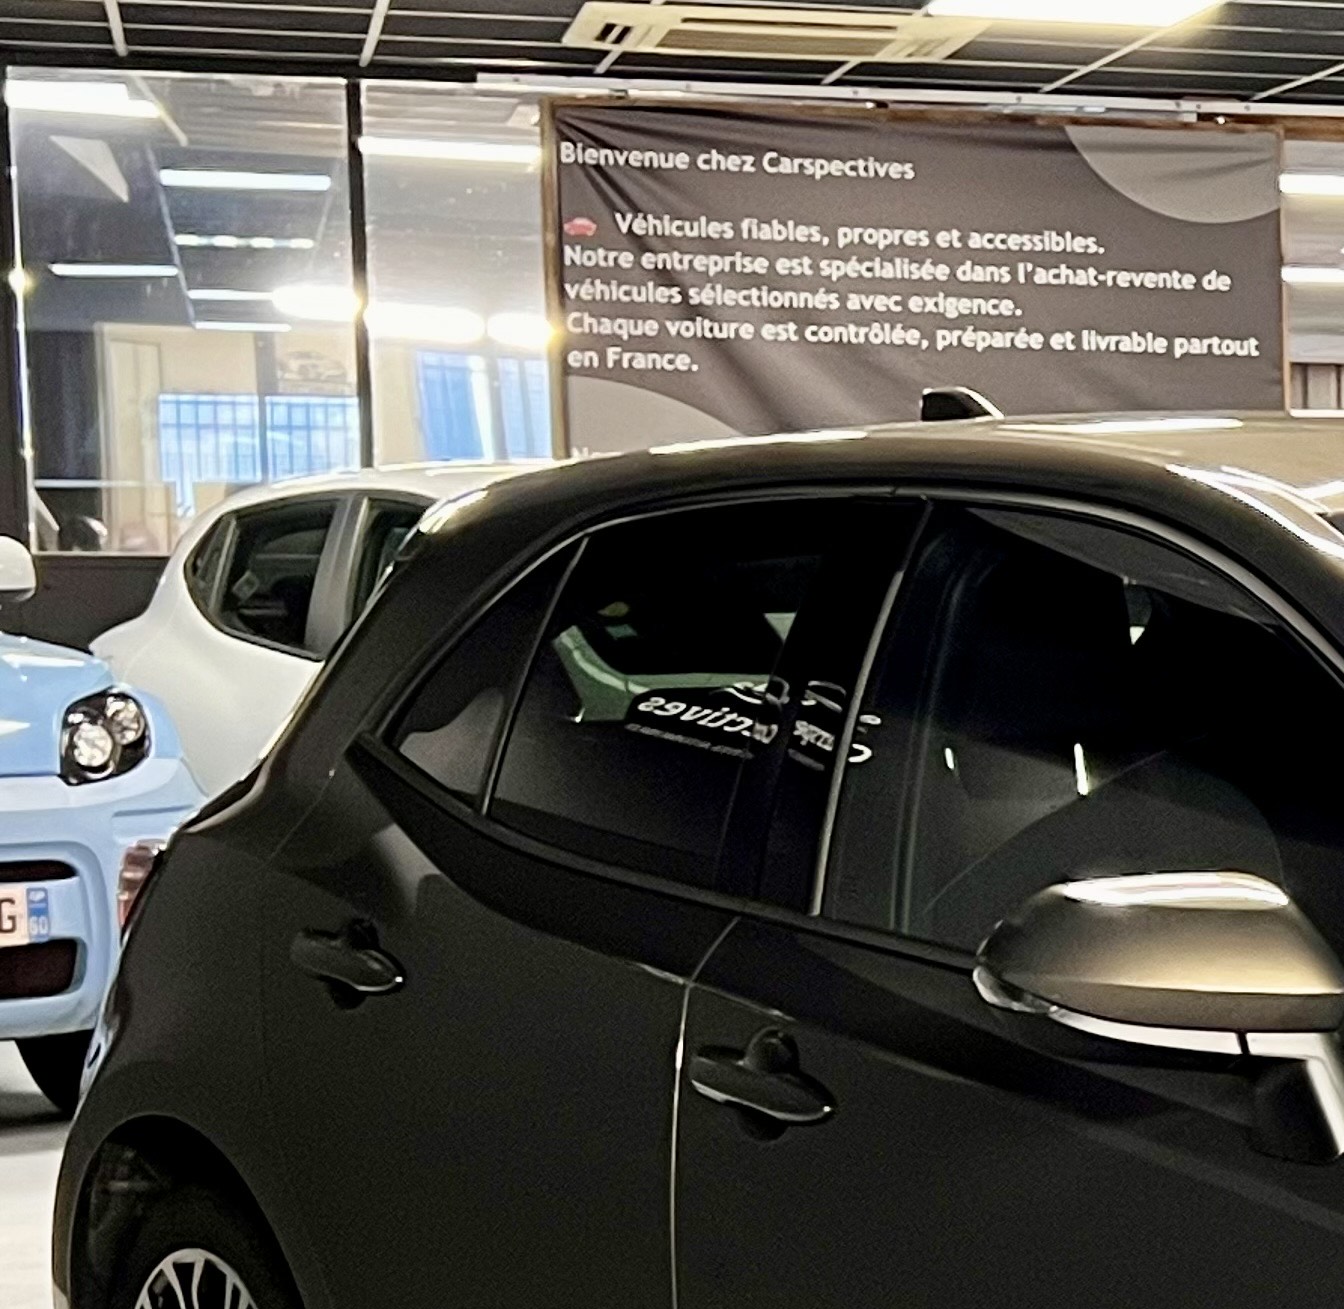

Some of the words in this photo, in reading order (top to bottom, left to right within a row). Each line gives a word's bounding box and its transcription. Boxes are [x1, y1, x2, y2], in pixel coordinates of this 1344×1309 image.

[560, 141, 689, 170] Bienvenue
[697, 149, 756, 172] chez
[762, 151, 915, 180] Carspectives
[614, 212, 733, 239] Véhicules
[741, 217, 829, 246] fiables,
[837, 226, 929, 250] propres
[935, 229, 962, 249] et
[967, 230, 1104, 254] accessibles.
[564, 245, 634, 268] Notre
[641, 250, 769, 277] entreprise
[775, 256, 813, 276] est
[819, 255, 950, 282] spécialisée
[956, 260, 1012, 283] dans
[1017, 261, 1197, 291] l'achat-revente
[1202, 269, 1232, 292] de
[564, 278, 682, 304] véhicules
[688, 282, 840, 309] sélectionnés
[846, 292, 903, 312] avec
[908, 292, 1022, 318] exigence.
[566, 311, 659, 340] Chaque
[665, 316, 754, 340] voiture
[761, 321, 799, 341] est
[804, 322, 928, 350] contrôlée,
[936, 325, 1044, 352] préparée
[1049, 331, 1076, 351] et
[1081, 329, 1168, 354] livrable
[1174, 336, 1260, 359] partout
[567, 349, 599, 369] en
[606, 346, 699, 372] France.
